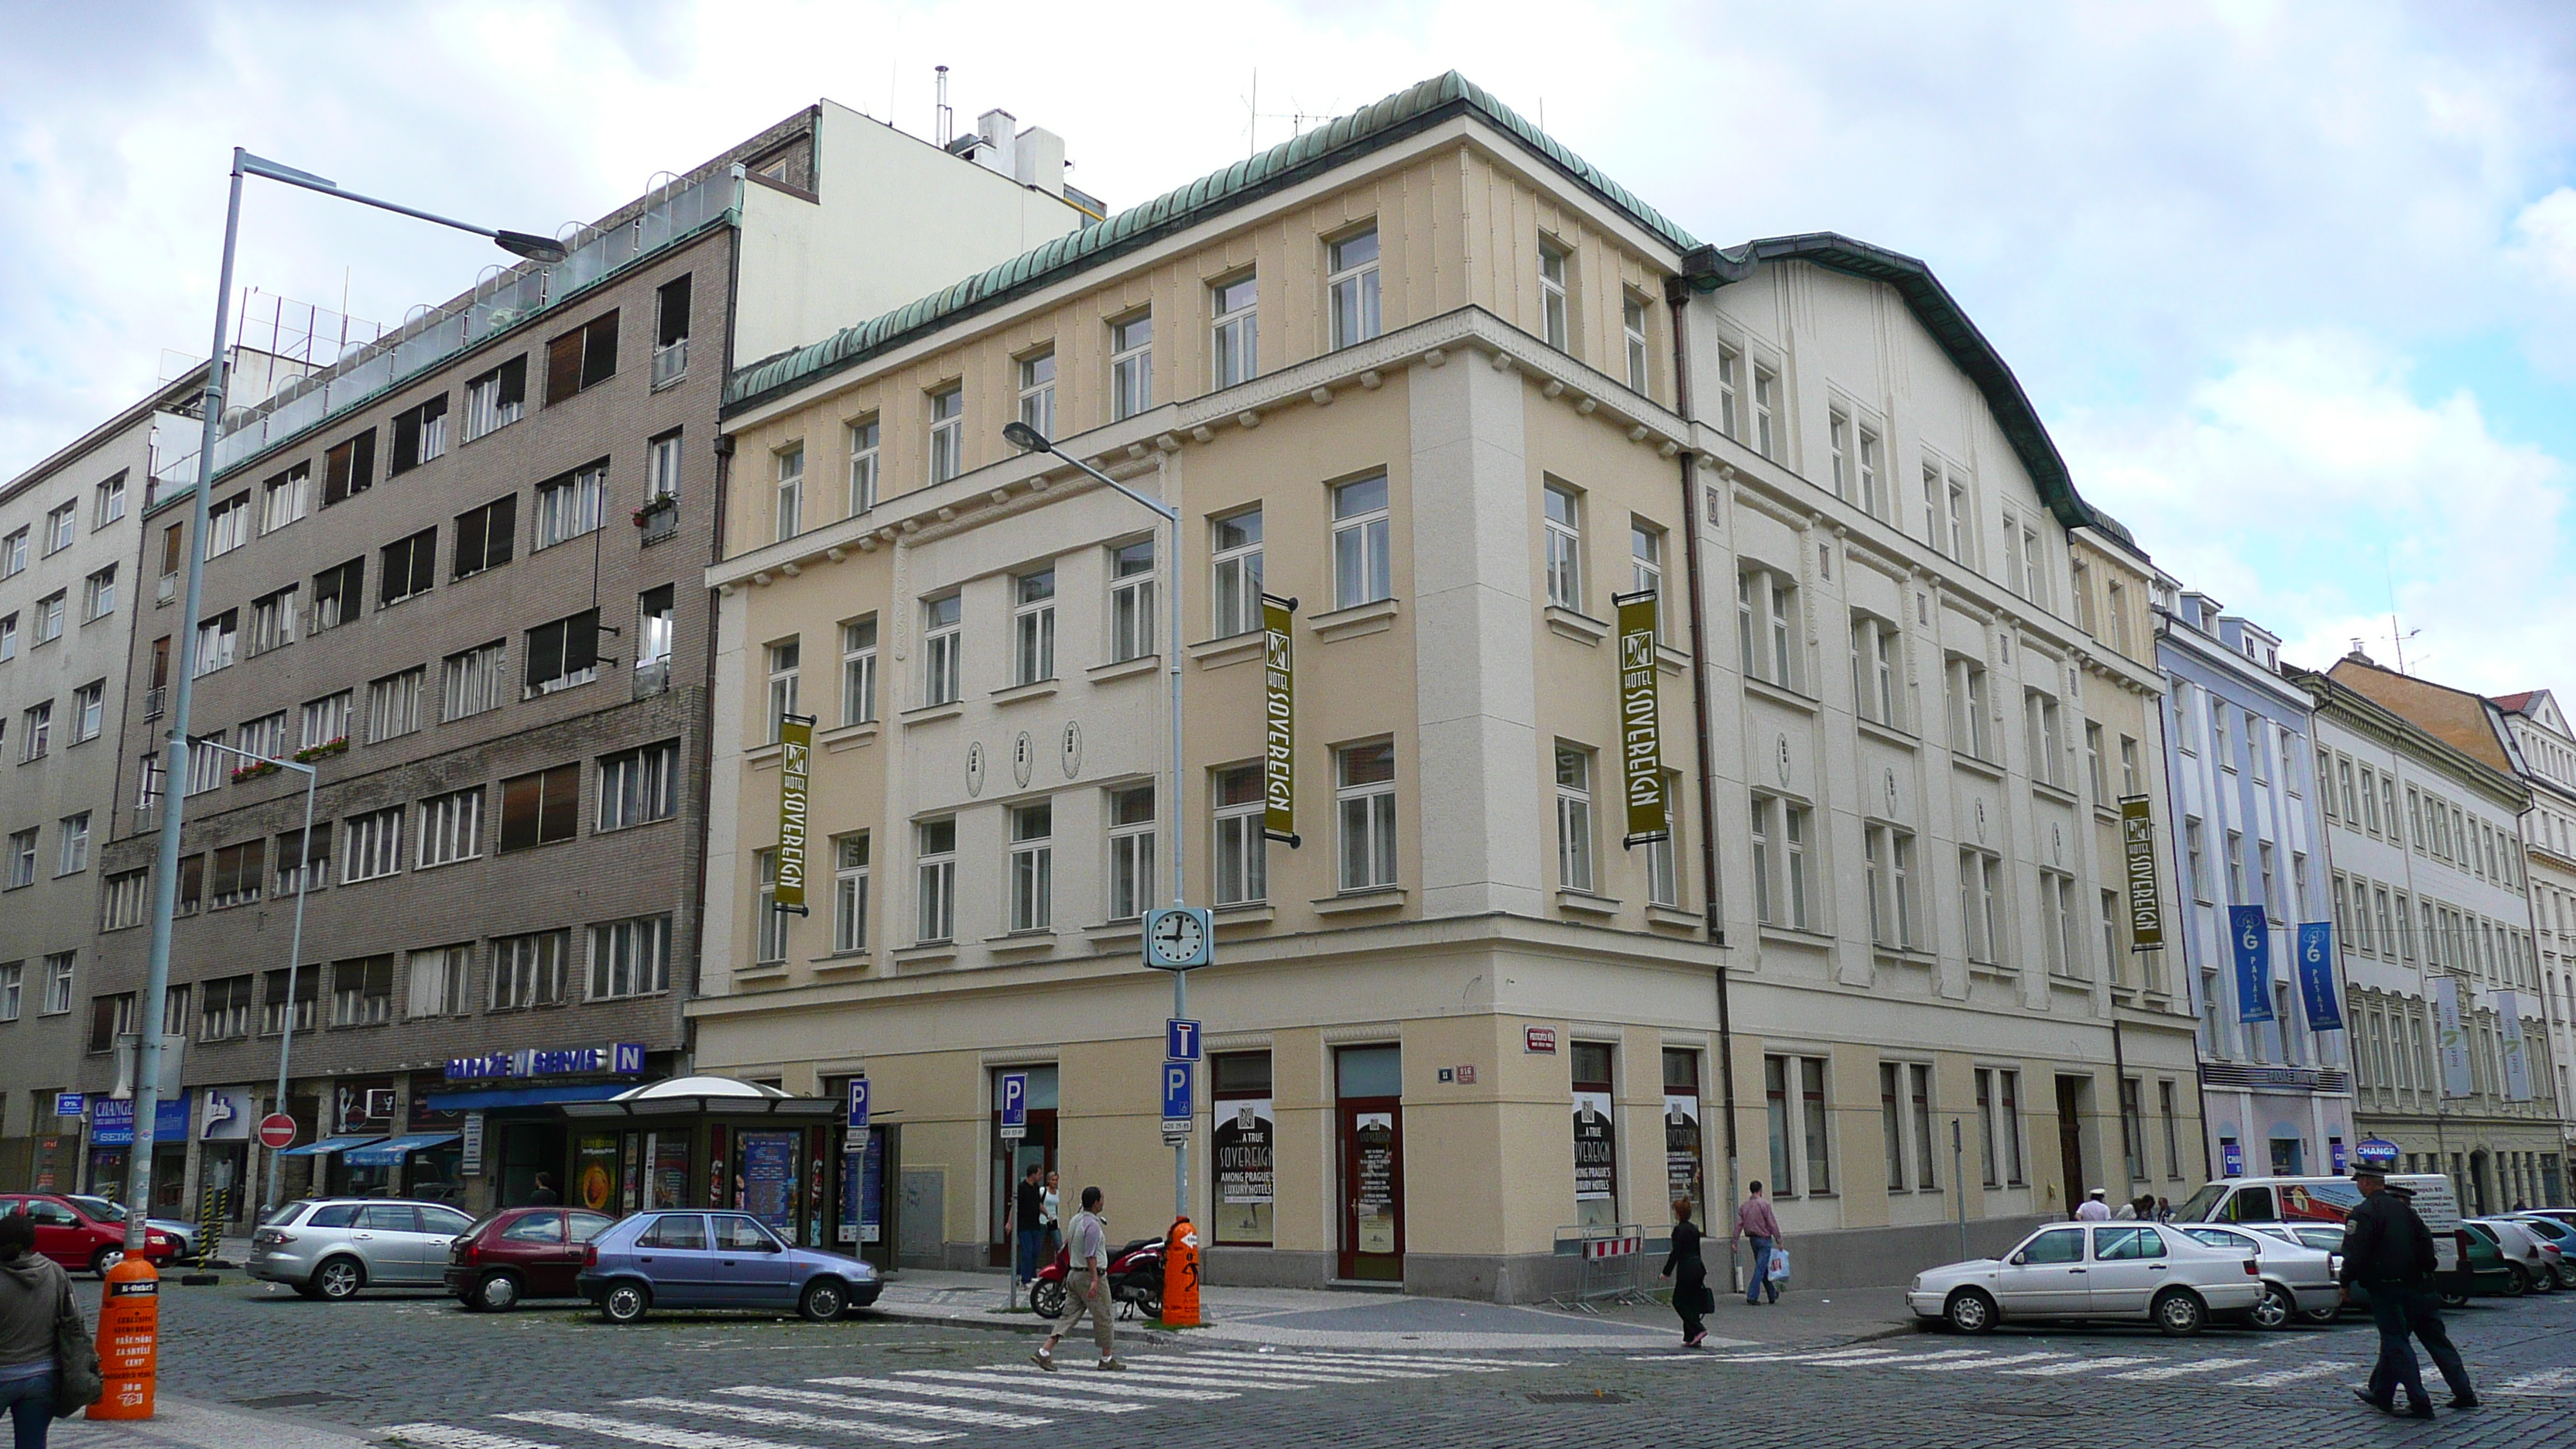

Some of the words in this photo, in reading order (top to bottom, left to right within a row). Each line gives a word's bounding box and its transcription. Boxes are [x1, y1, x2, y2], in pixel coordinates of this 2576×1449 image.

[1268, 671, 1289, 691] HOTEL
[1625, 670, 1652, 689] HOTEL
[1268, 691, 1290, 811] SOVEREIGN
[1625, 689, 1660, 807] SOVEREIGN
[784, 775, 806, 792] HOTEL
[779, 791, 806, 889] SOVEREIGN
[2129, 842, 2150, 855] HOTEL
[2130, 855, 2158, 930] SOVEREIGN
[533, 1049, 602, 1074] SERVIS
[622, 1047, 639, 1070] N
[2448, 1047, 2458, 1067] hotel
[2510, 1055, 2519, 1074] hotel
[1169, 1069, 1186, 1101] P
[852, 1085, 865, 1113] P
[1007, 1081, 1021, 1110] P
[95, 1101, 134, 1117] CHANGE
[1249, 1132, 1264, 1142] TRUE
[1590, 1127, 1601, 1137] TRUE
[1574, 1141, 1610, 1163] OVEREIGN
[1221, 1172, 1244, 1183] AMONG
[1245, 1171, 1274, 1183] PRAGUE'S
[1589, 1167, 1611, 1177] PRAGUE'S
[1225, 1184, 1248, 1194] LUXURY
[1249, 1184, 1273, 1194] HOTELS
[1576, 1180, 1591, 1191] UXURY
[1592, 1180, 1609, 1190] HOTELS
